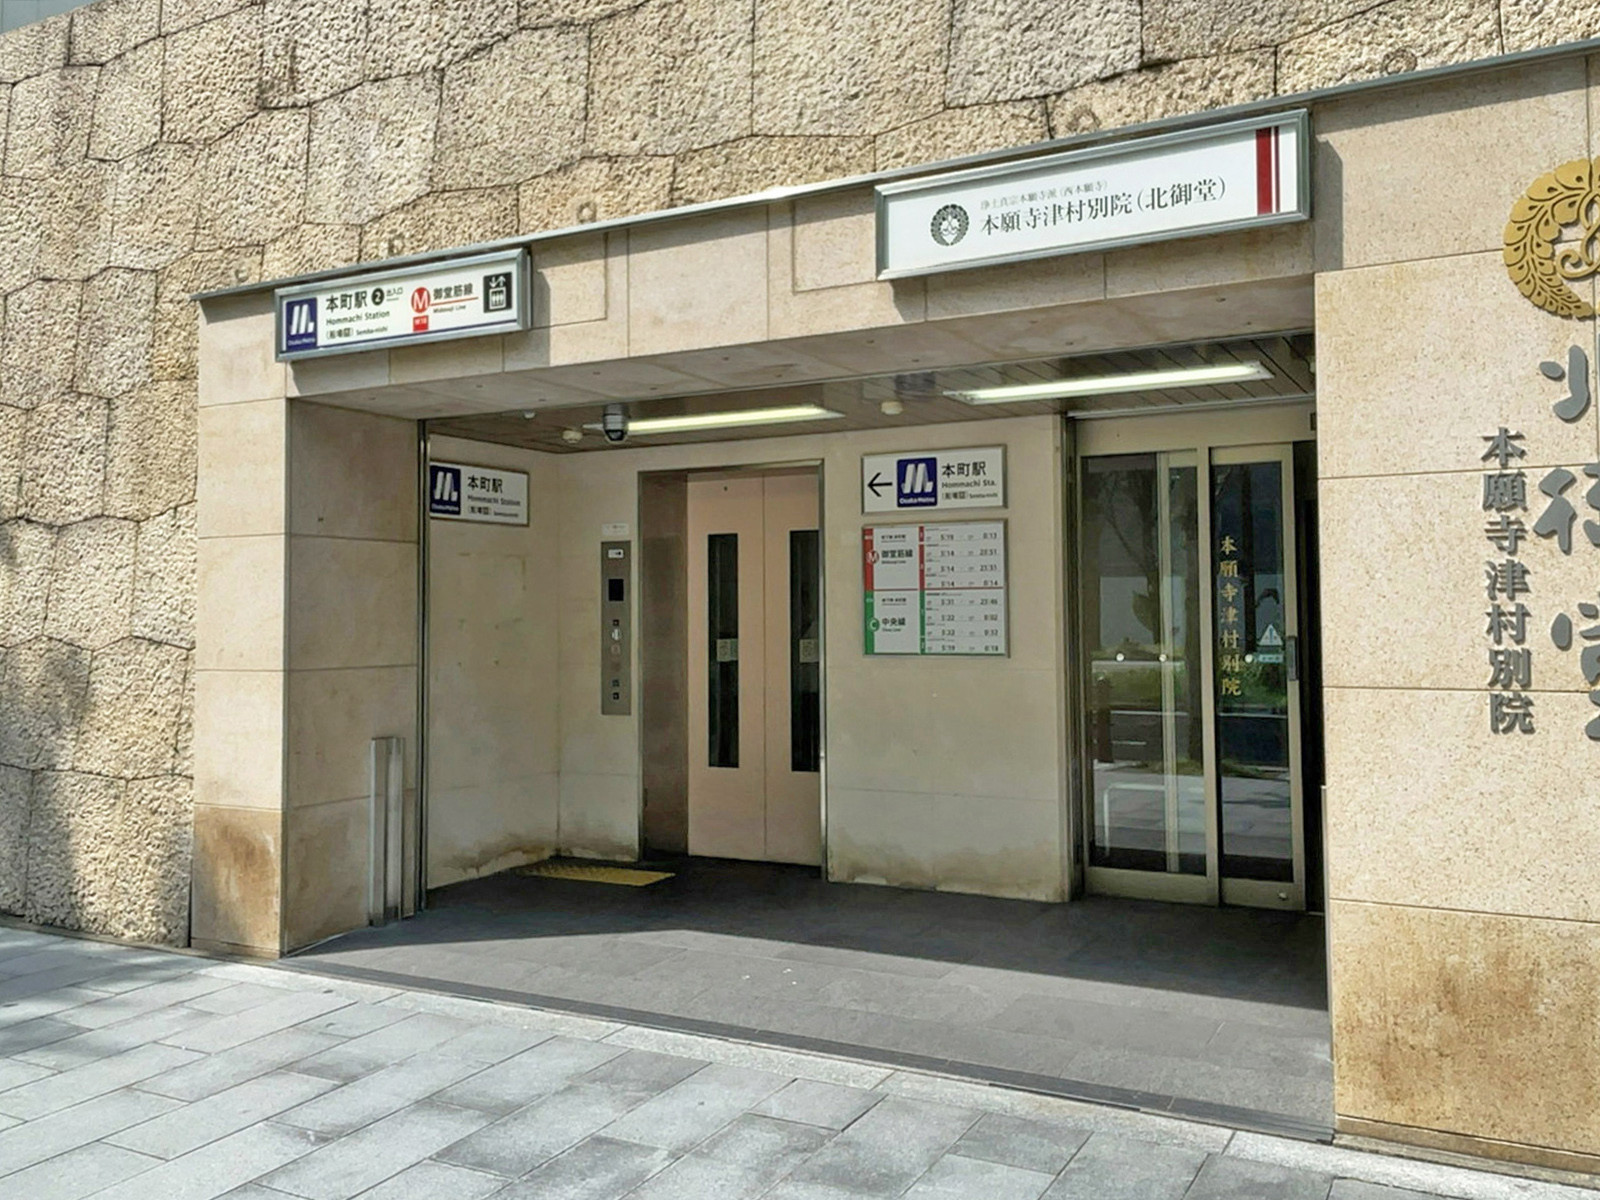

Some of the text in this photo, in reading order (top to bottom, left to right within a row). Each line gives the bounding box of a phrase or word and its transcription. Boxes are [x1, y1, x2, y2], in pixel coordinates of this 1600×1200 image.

[980, 175, 1227, 236] 本願寺津村別院（北御堂）
[326, 290, 368, 313] 本町駅
[433, 283, 473, 300] 御堂筋線
[365, 311, 390, 321] Station
[941, 461, 986, 478] 本町駅
[467, 474, 503, 493] 本町駅
[1480, 427, 1535, 734] 本願寺津村別院
[1219, 535, 1242, 696] 本願寺津村別院
